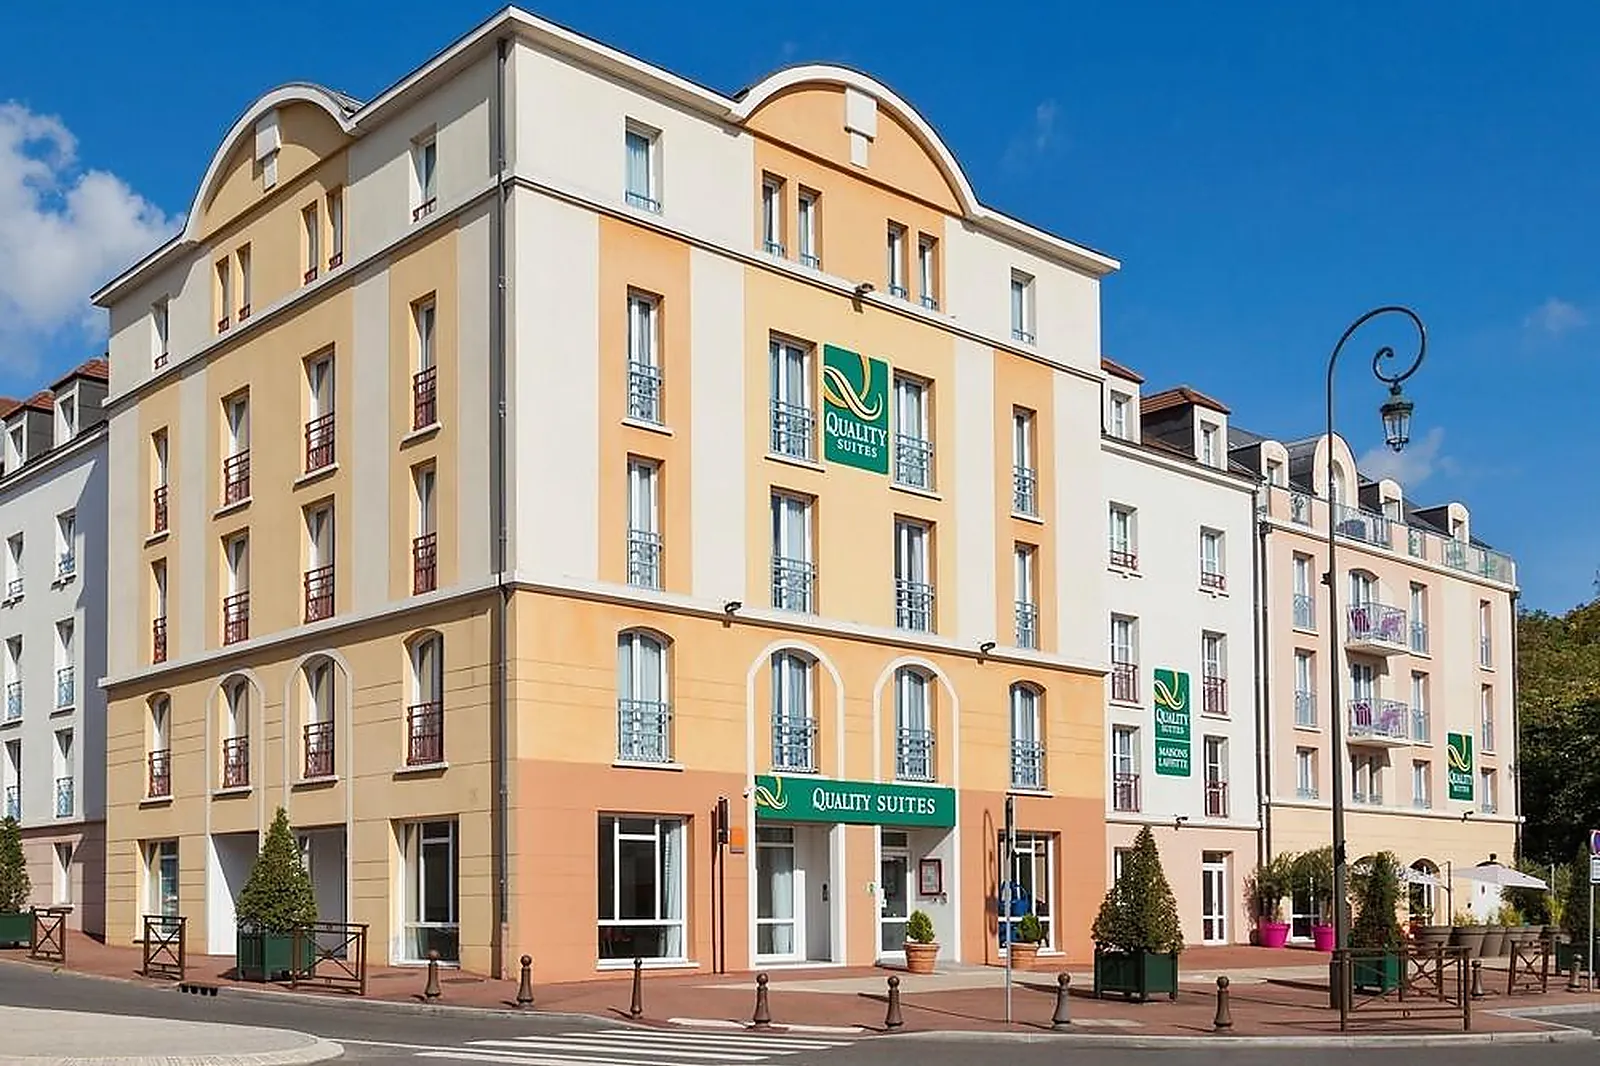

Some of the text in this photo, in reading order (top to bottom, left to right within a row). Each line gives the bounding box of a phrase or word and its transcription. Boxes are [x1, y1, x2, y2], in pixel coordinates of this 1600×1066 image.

[826, 411, 887, 447] QUALITY
[837, 438, 878, 458] SUITES
[1156, 708, 1188, 726] QUALITY
[812, 787, 936, 815] QUALITY SUITES
